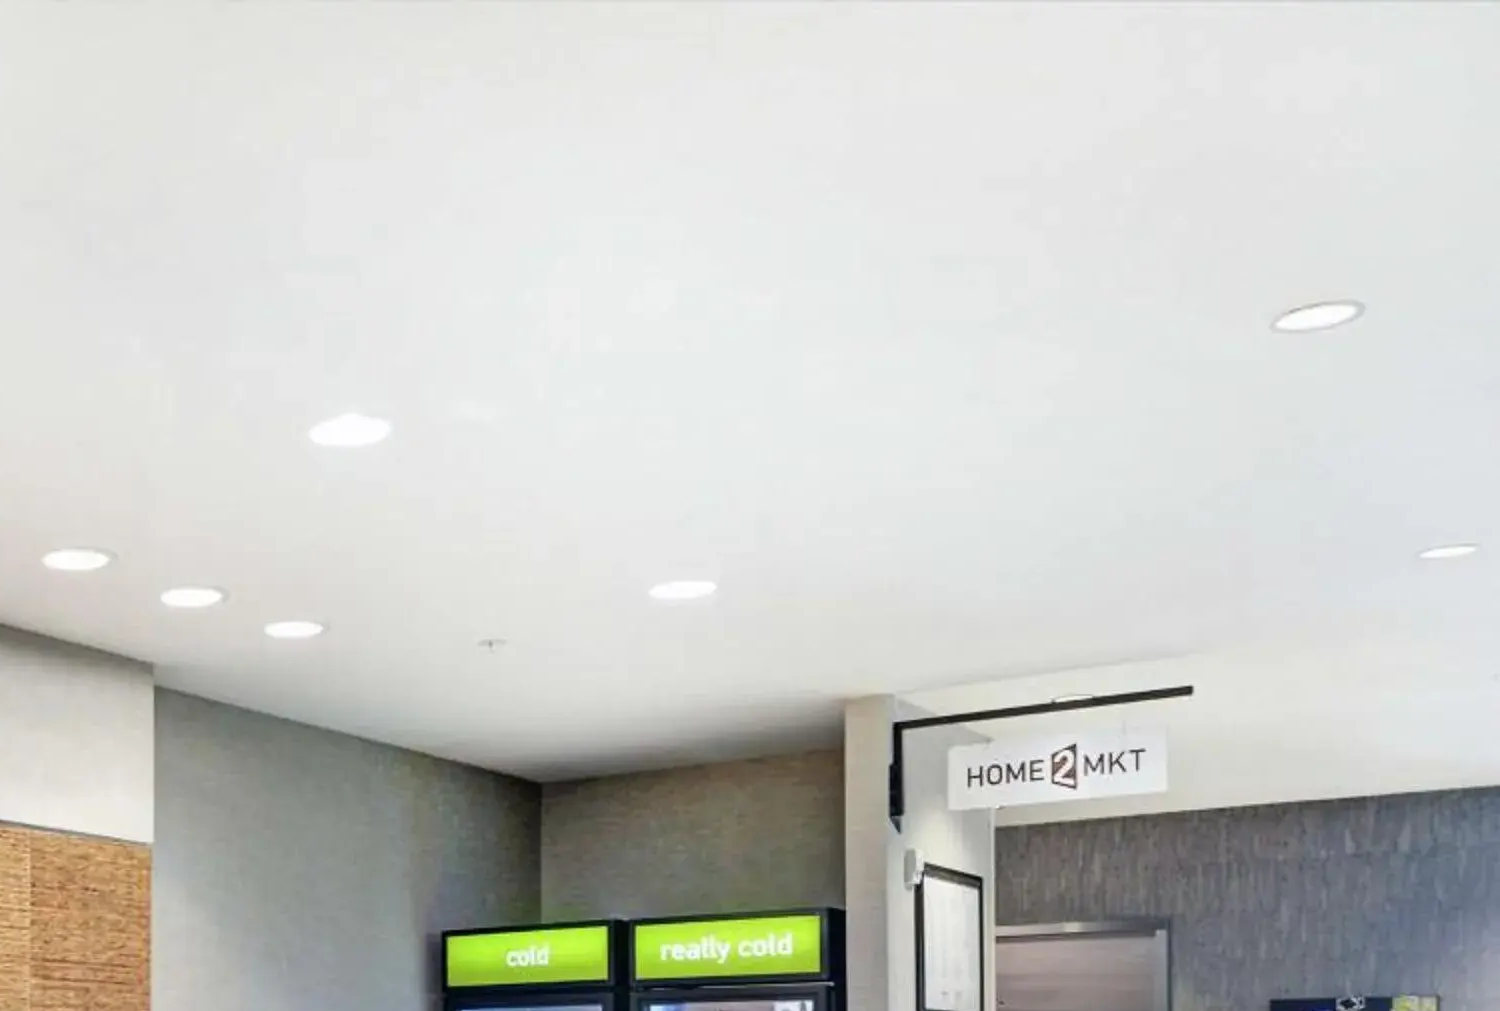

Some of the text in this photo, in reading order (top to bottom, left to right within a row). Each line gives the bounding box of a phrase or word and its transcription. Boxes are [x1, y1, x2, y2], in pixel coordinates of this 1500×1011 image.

[506, 945, 549, 967] cold
[660, 932, 793, 964] really cold
